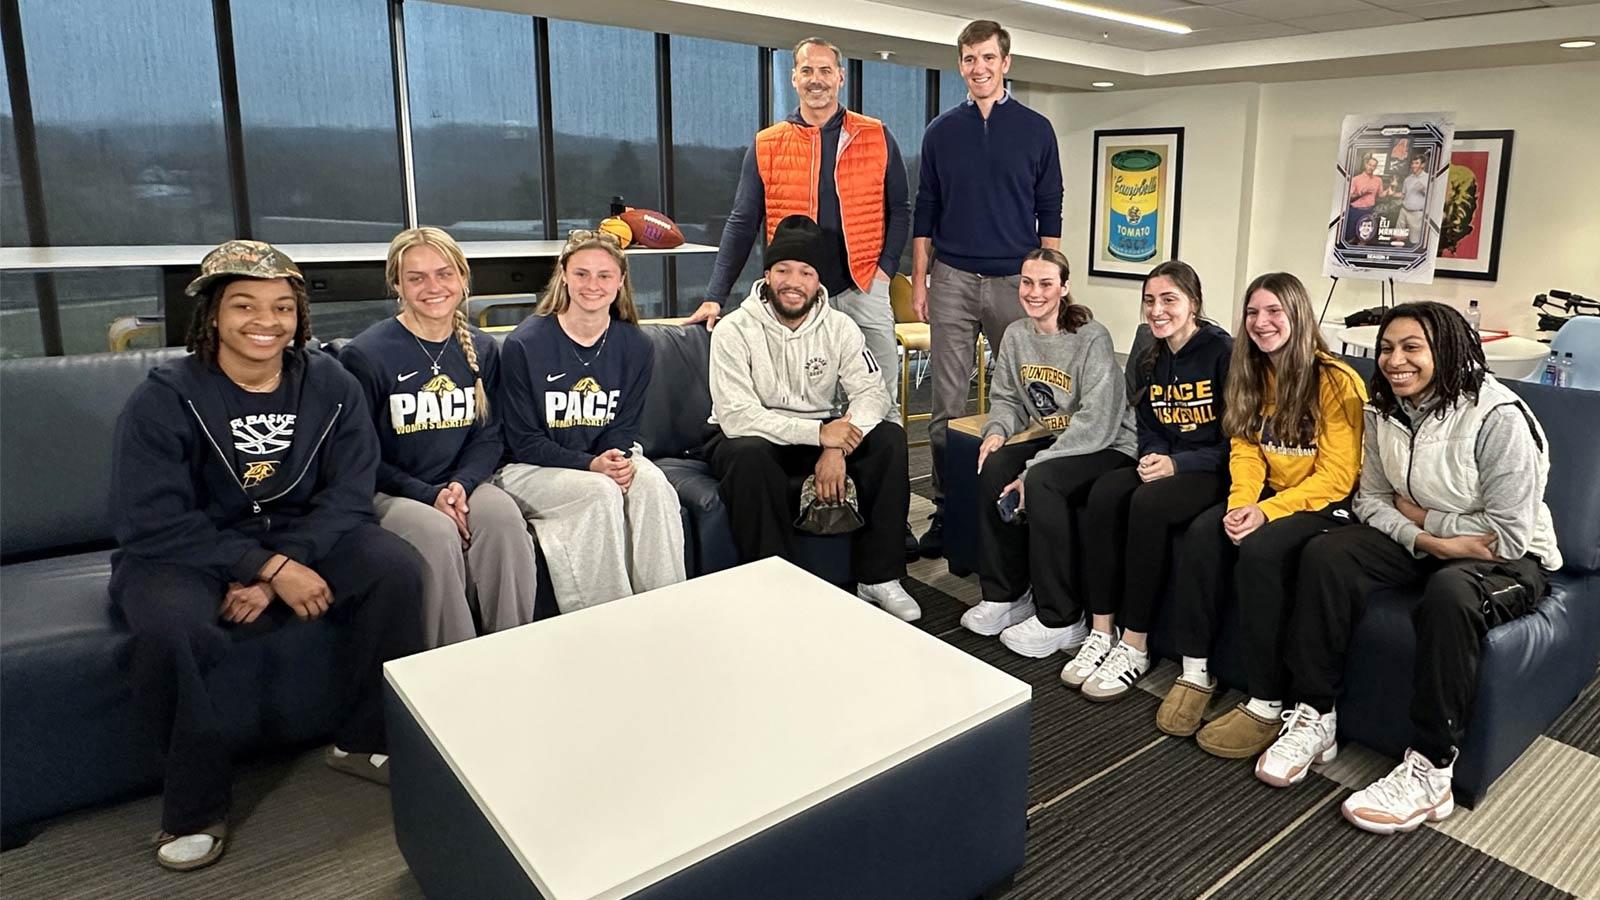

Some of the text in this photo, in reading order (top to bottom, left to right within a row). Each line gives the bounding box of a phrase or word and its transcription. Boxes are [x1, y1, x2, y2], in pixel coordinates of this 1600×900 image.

[1117, 225, 1150, 238] TOMATO
[1378, 228, 1410, 237] MANNING
[1379, 220, 1390, 228] ELI
[1027, 365, 1073, 396] UNIVERSIT
[1150, 379, 1213, 402] PACE
[389, 386, 477, 430] PACE
[545, 389, 620, 426] PACE
[245, 413, 297, 425] BASKE
